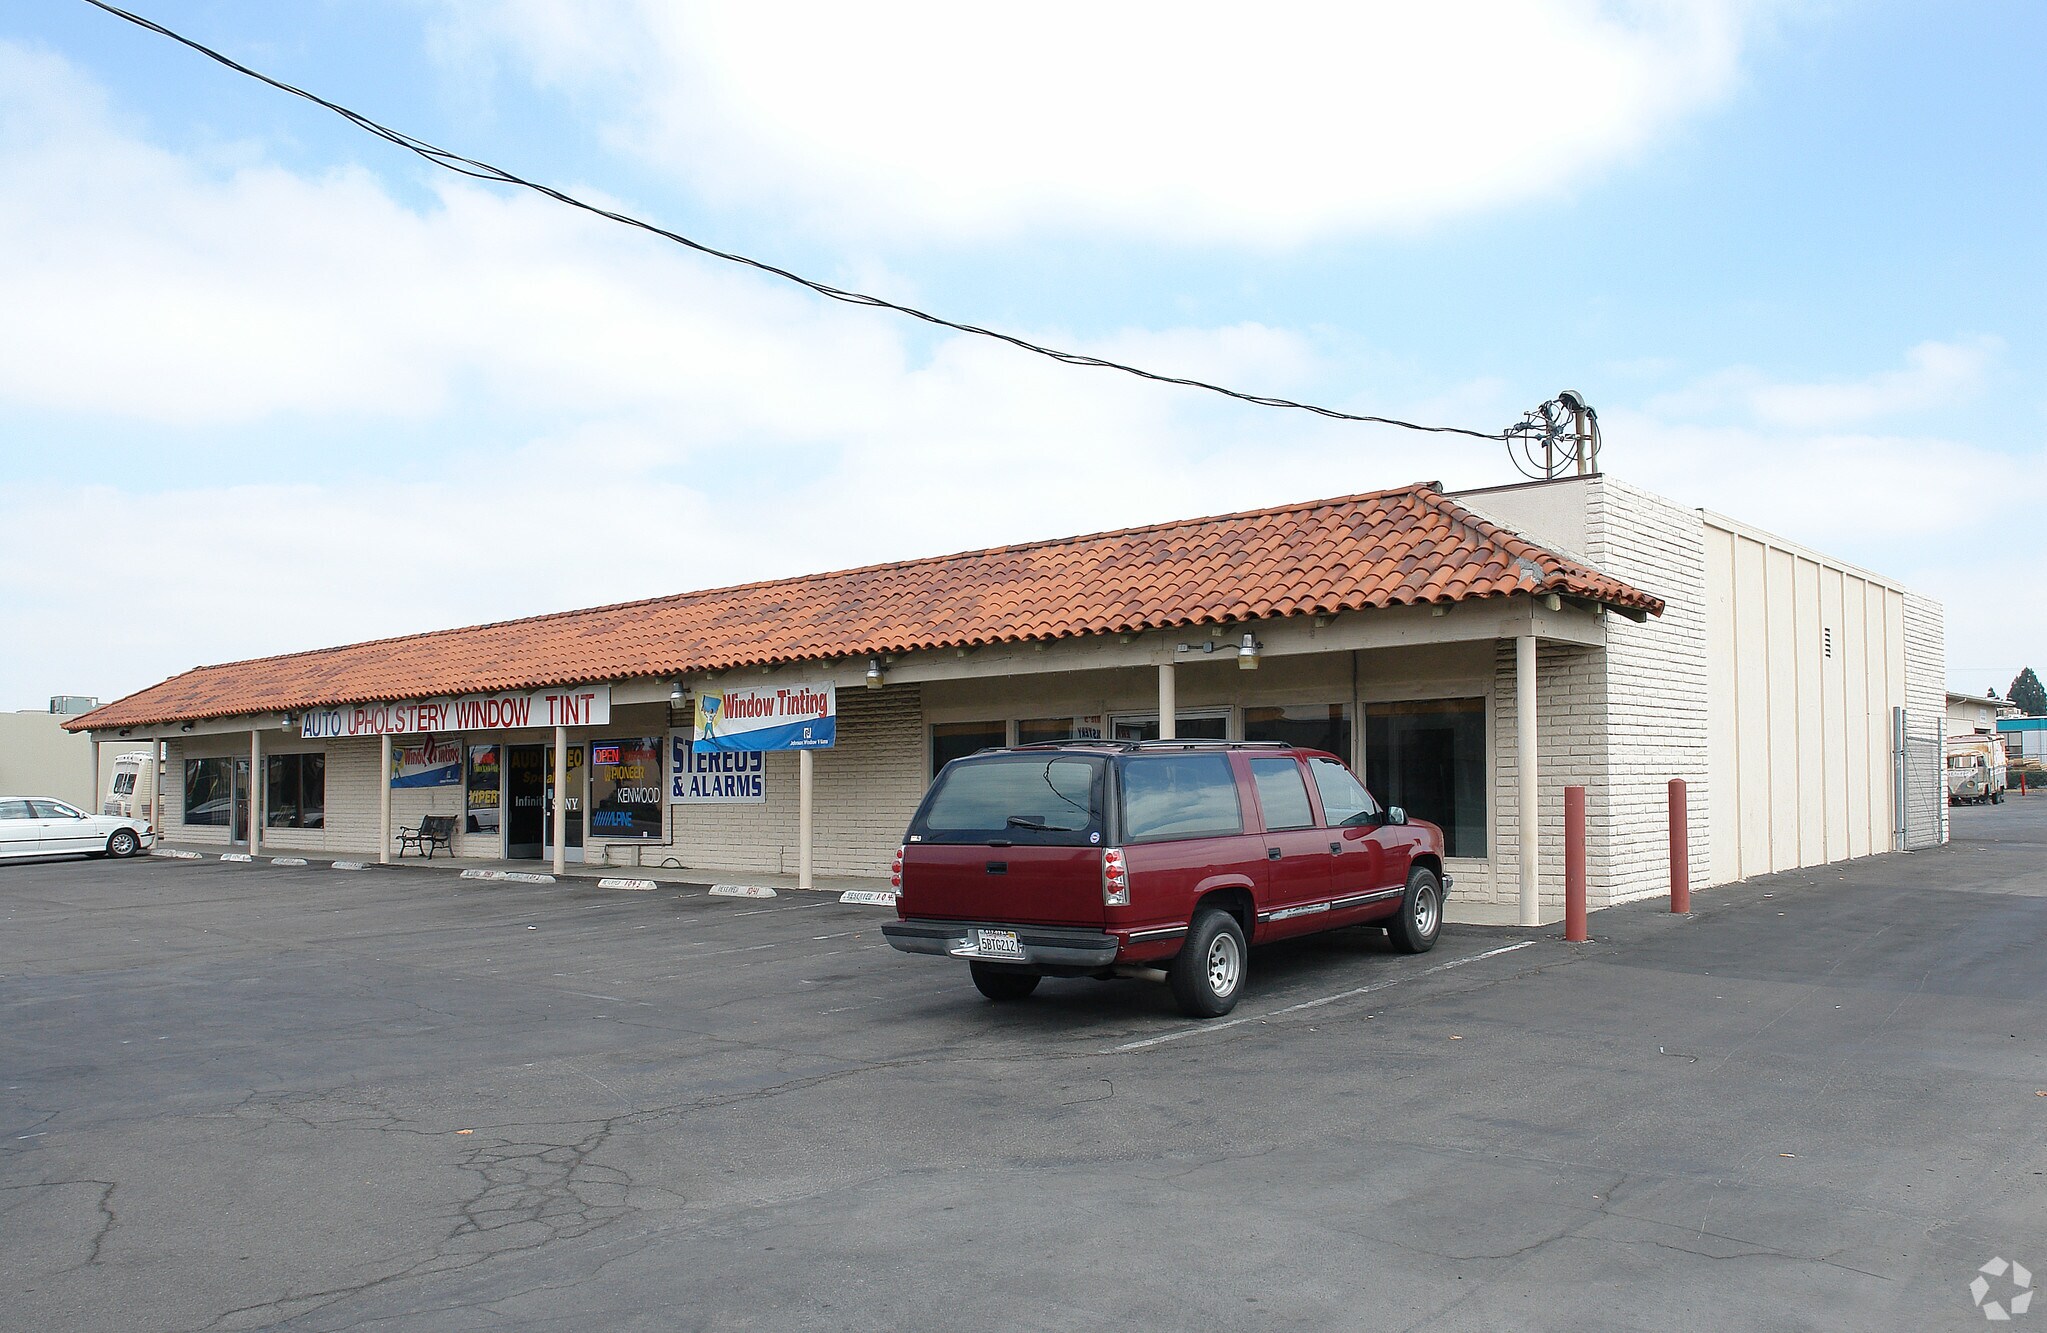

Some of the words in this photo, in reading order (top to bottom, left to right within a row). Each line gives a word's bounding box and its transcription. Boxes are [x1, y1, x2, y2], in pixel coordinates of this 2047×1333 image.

[722, 692, 775, 719] Window
[776, 687, 828, 718] Tinting
[303, 711, 342, 737] AUTO
[347, 703, 449, 735] UPHOLSTERY
[455, 697, 531, 728] WINDOW
[545, 693, 595, 725] TINT
[549, 748, 582, 768] VEO
[595, 750, 619, 763] OPEN
[673, 736, 762, 773] STEREOS
[611, 766, 645, 780] PIONEER
[673, 776, 685, 797] &
[689, 775, 762, 797] ALARMS
[469, 790, 498, 804] VIPER
[617, 787, 660, 804] KENWOOD
[552, 797, 578, 810] SNY
[876, 893, 893, 901] 104
[981, 938, 1016, 952] 5BTG212
